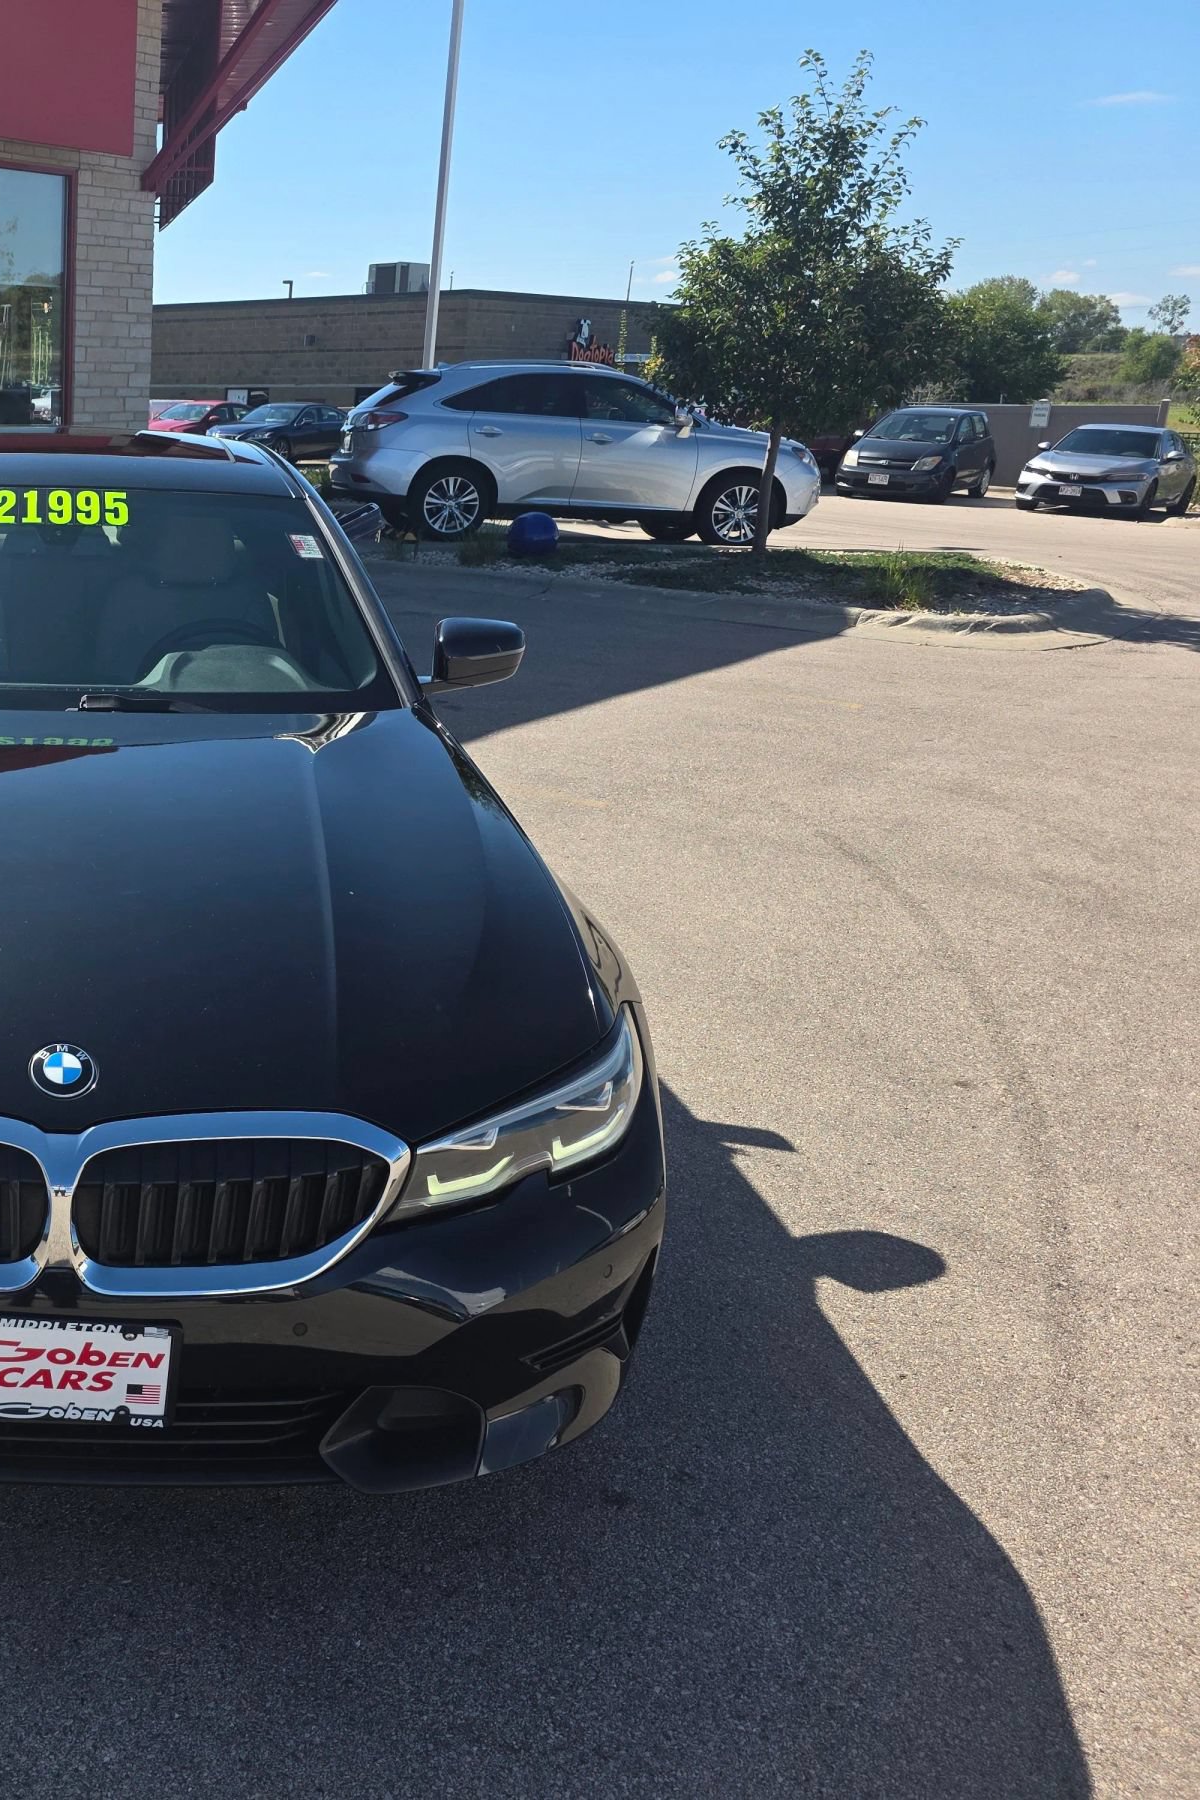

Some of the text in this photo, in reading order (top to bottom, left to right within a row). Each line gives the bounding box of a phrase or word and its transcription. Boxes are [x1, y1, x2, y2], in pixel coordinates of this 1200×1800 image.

[39, 1044, 89, 1061] BMW
[0, 1317, 122, 1334] MIDDLETON
[130, 1417, 164, 1428] USA
